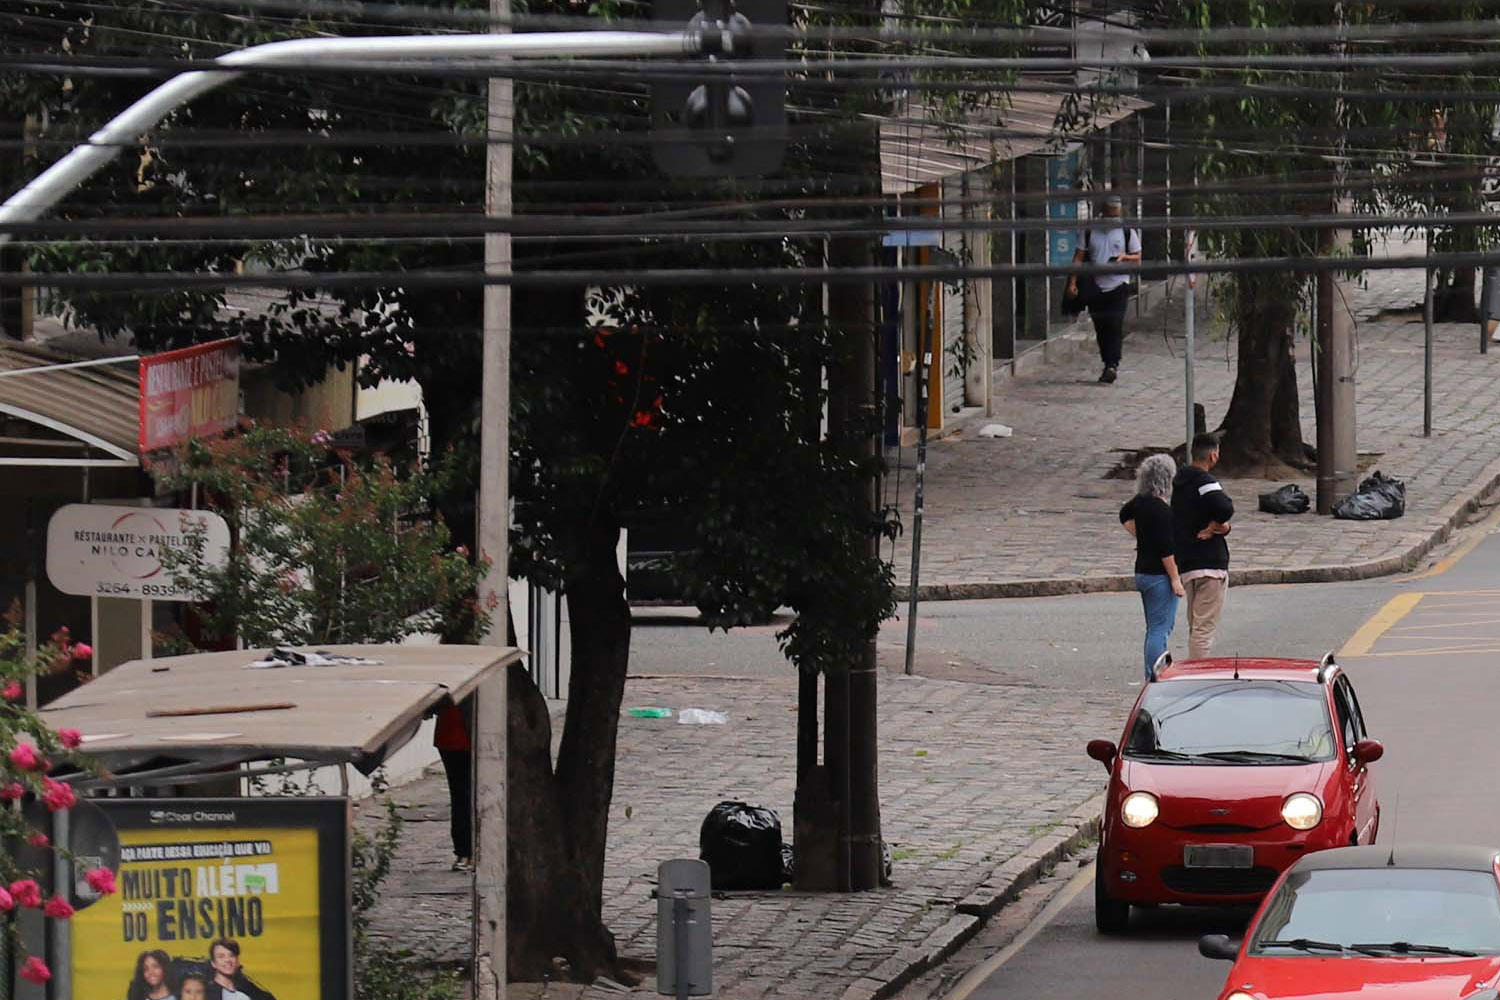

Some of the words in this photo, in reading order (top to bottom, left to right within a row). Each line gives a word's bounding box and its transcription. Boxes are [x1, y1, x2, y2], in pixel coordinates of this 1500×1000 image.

[74, 530, 135, 544] RESTAURANTE
[91, 546, 128, 556] NILO
[142, 584, 176, 596] 8939
[193, 810, 235, 822] Channel
[136, 846, 163, 860] PARTE
[234, 842, 253, 855] QUE
[255, 841, 271, 854] VAI
[123, 867, 192, 899] MUITO
[196, 857, 280, 896] ALÉM
[124, 912, 147, 942] DO
[157, 896, 264, 941] ENSINO
